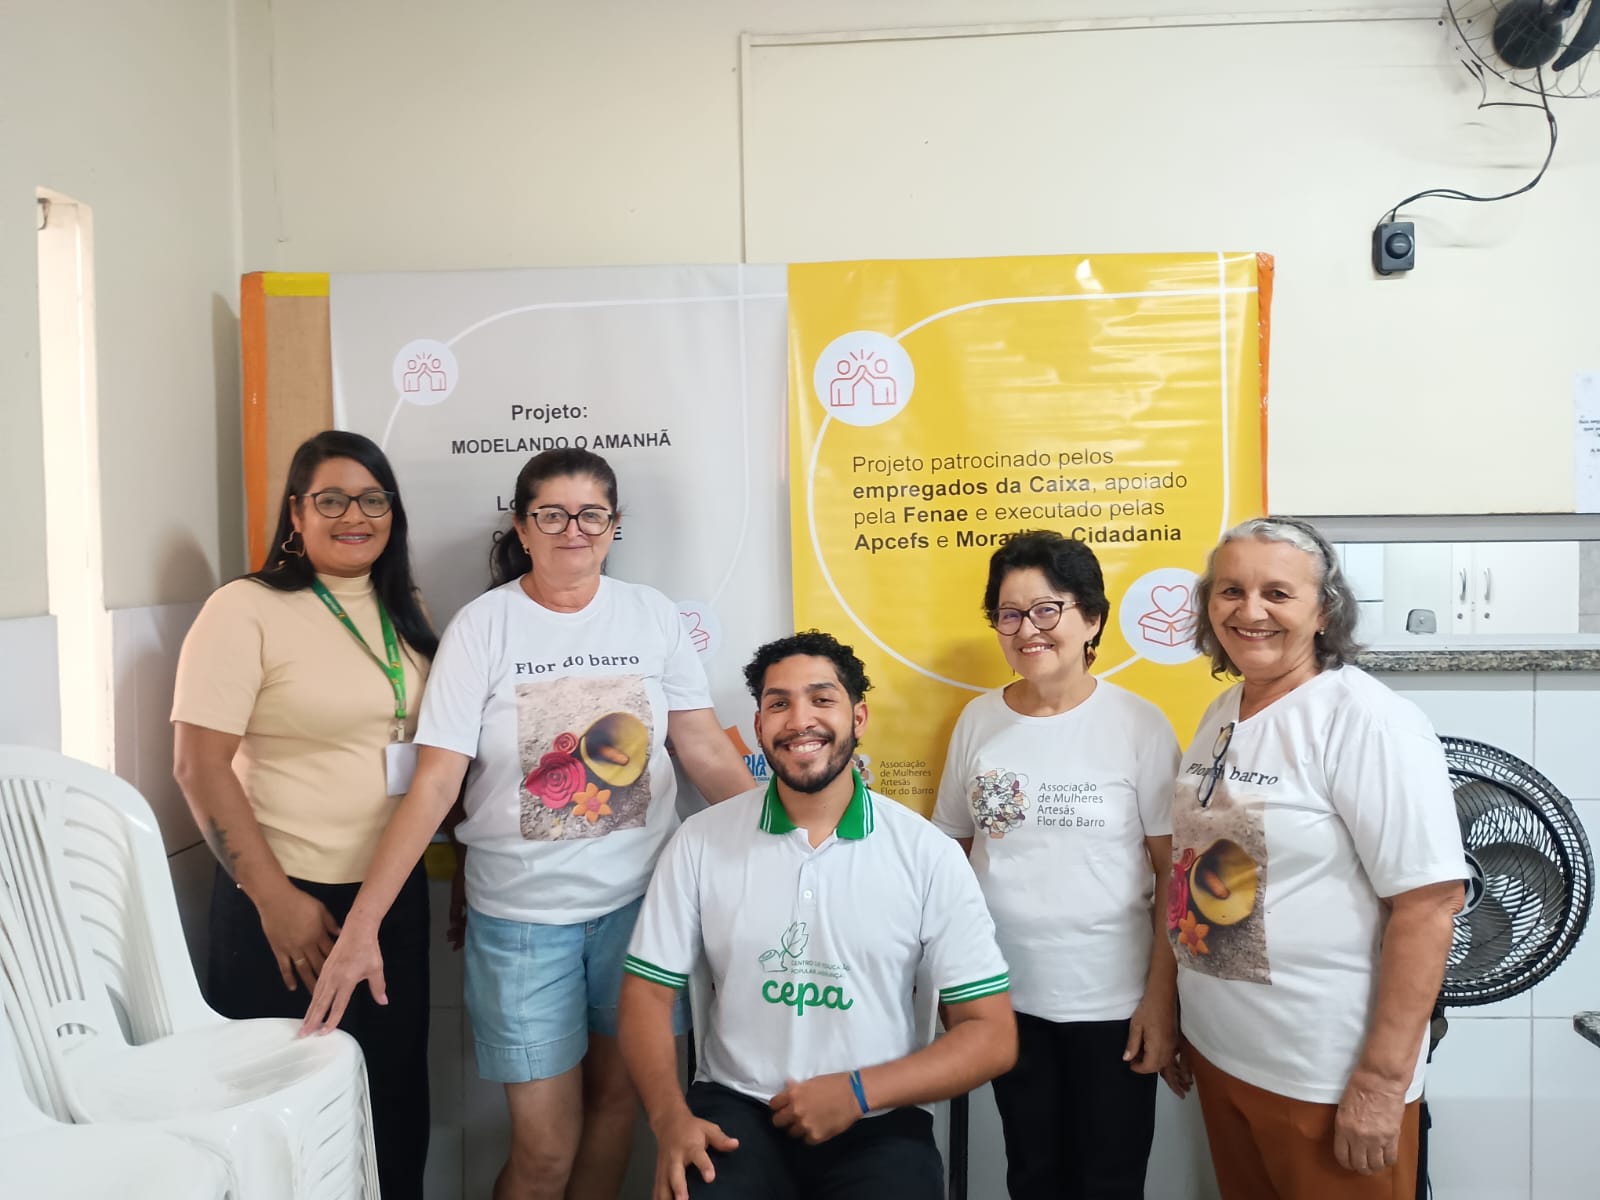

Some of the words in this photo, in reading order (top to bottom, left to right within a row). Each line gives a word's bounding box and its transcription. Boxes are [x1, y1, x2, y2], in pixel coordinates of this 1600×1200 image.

[511, 403, 588, 423] Projeto:
[451, 436, 569, 454] MODELANDO
[574, 435, 588, 449] O
[592, 429, 671, 449] AMANHÃ
[853, 455, 924, 476] Projeto
[931, 450, 1051, 475] patrocinado
[1058, 448, 1114, 470] pelos
[853, 479, 988, 502] empregados
[996, 477, 1021, 494] da
[1029, 475, 1096, 493] Caixa,
[1104, 472, 1187, 494] apoiado
[854, 507, 896, 529] pela
[903, 507, 968, 523] Fenae
[975, 507, 988, 521] e
[994, 501, 1102, 520] executado
[1109, 499, 1165, 520] pelas
[854, 532, 930, 554] Apcefs
[936, 535, 949, 548] e
[1071, 524, 1182, 544] Cidadania
[515, 662, 557, 675] Flor
[562, 656, 584, 668] do
[588, 654, 640, 667] barro
[880, 760, 926, 769] Associação
[880, 769, 891, 777] de
[893, 768, 931, 777] Mulheres
[1229, 766, 1279, 785] barro
[898, 787, 910, 795] do
[1038, 782, 1097, 794] Associação
[1037, 793, 1052, 803] de
[1053, 793, 1104, 804] Mulheres
[1037, 804, 1075, 815] Artesãs
[1037, 817, 1056, 827] Flor
[1058, 816, 1073, 827] do
[1076, 817, 1105, 827] Barro
[762, 979, 854, 1017] cepa
